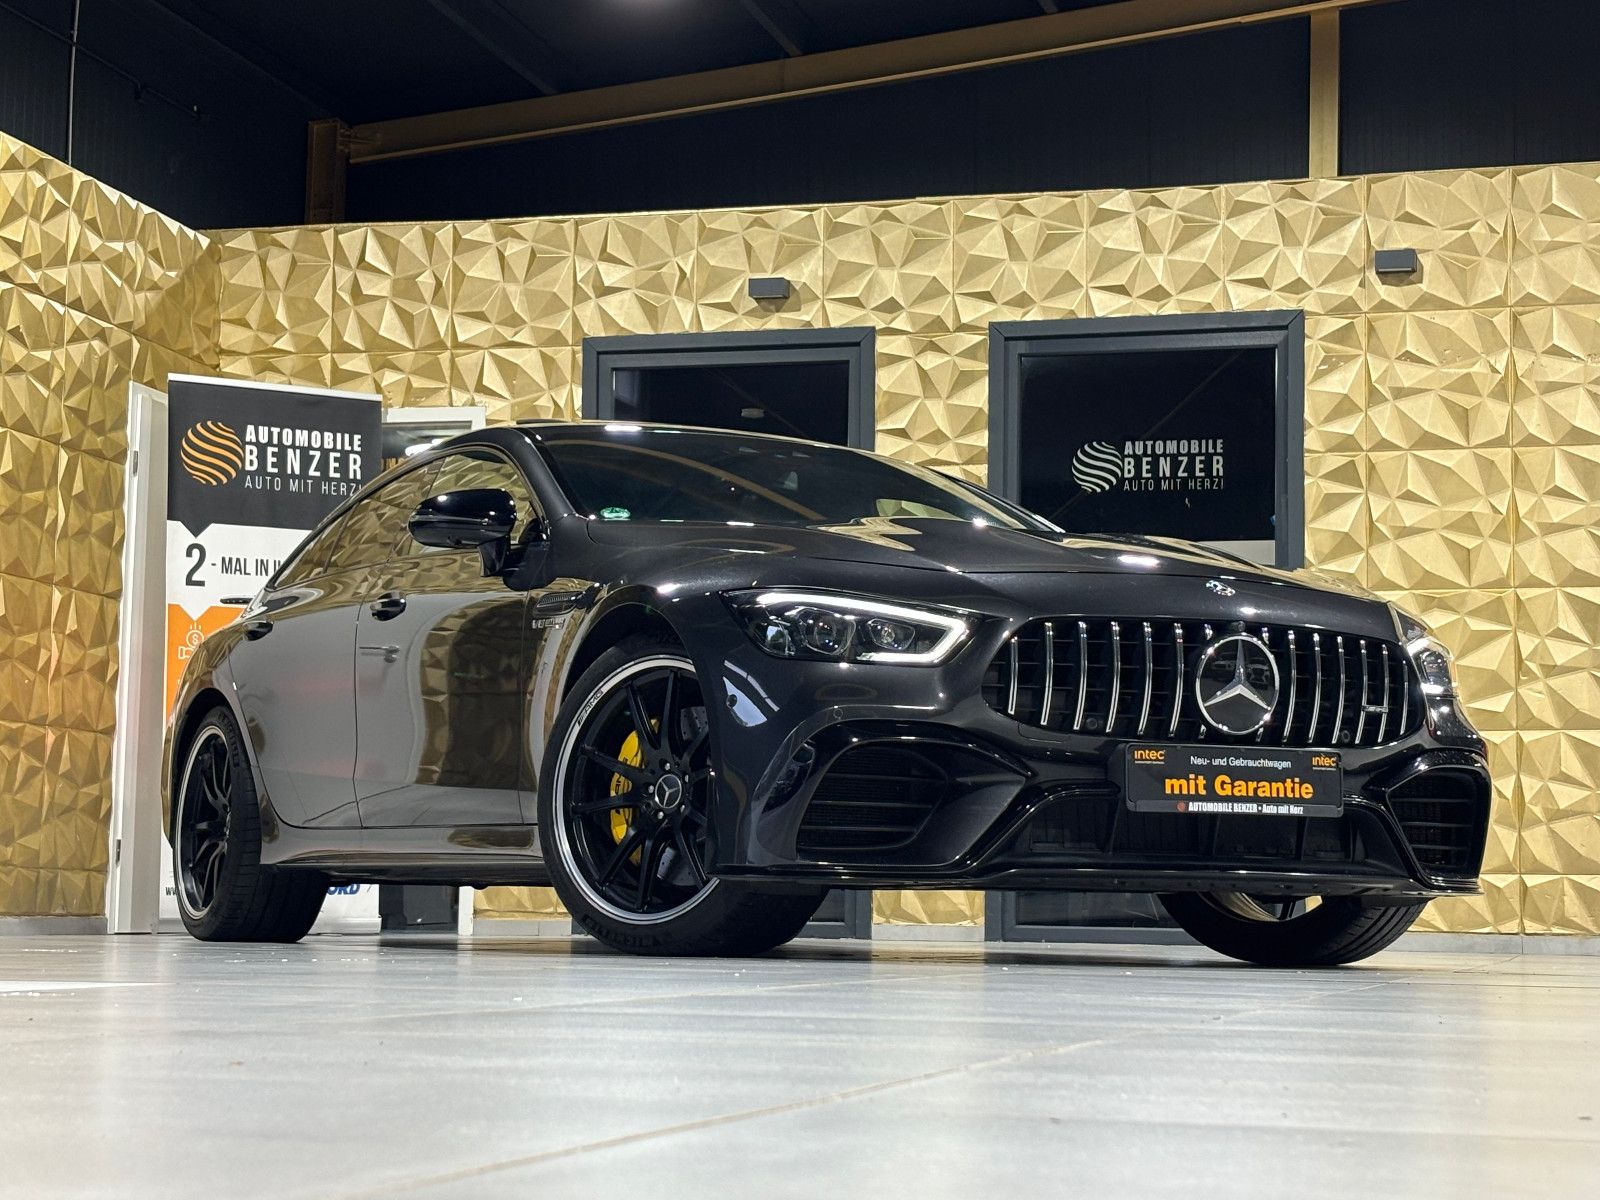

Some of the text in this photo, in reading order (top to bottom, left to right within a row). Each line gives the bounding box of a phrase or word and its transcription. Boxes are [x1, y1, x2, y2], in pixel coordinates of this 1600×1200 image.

[245, 424, 362, 452] AUTOMOBILE
[1123, 439, 1224, 455] AUTOMOBILE
[244, 444, 362, 480] BENZER
[1123, 455, 1224, 478] BENZER
[244, 475, 281, 491] AUTO
[289, 478, 314, 494] MIT
[1123, 479, 1154, 491] AUTO
[1160, 479, 1181, 491] MIT
[185, 543, 207, 587] 2
[221, 556, 252, 576] MAL
[255, 558, 269, 577] IN
[1134, 750, 1165, 760] intec
[1190, 756, 1292, 769] Neu- und Gebrauchtwagen
[1312, 757, 1336, 767] intec
[1165, 774, 1314, 799] mit Garantie
[1188, 802, 1304, 815] AUTOMOBILE BENZER Auto mit Herz
